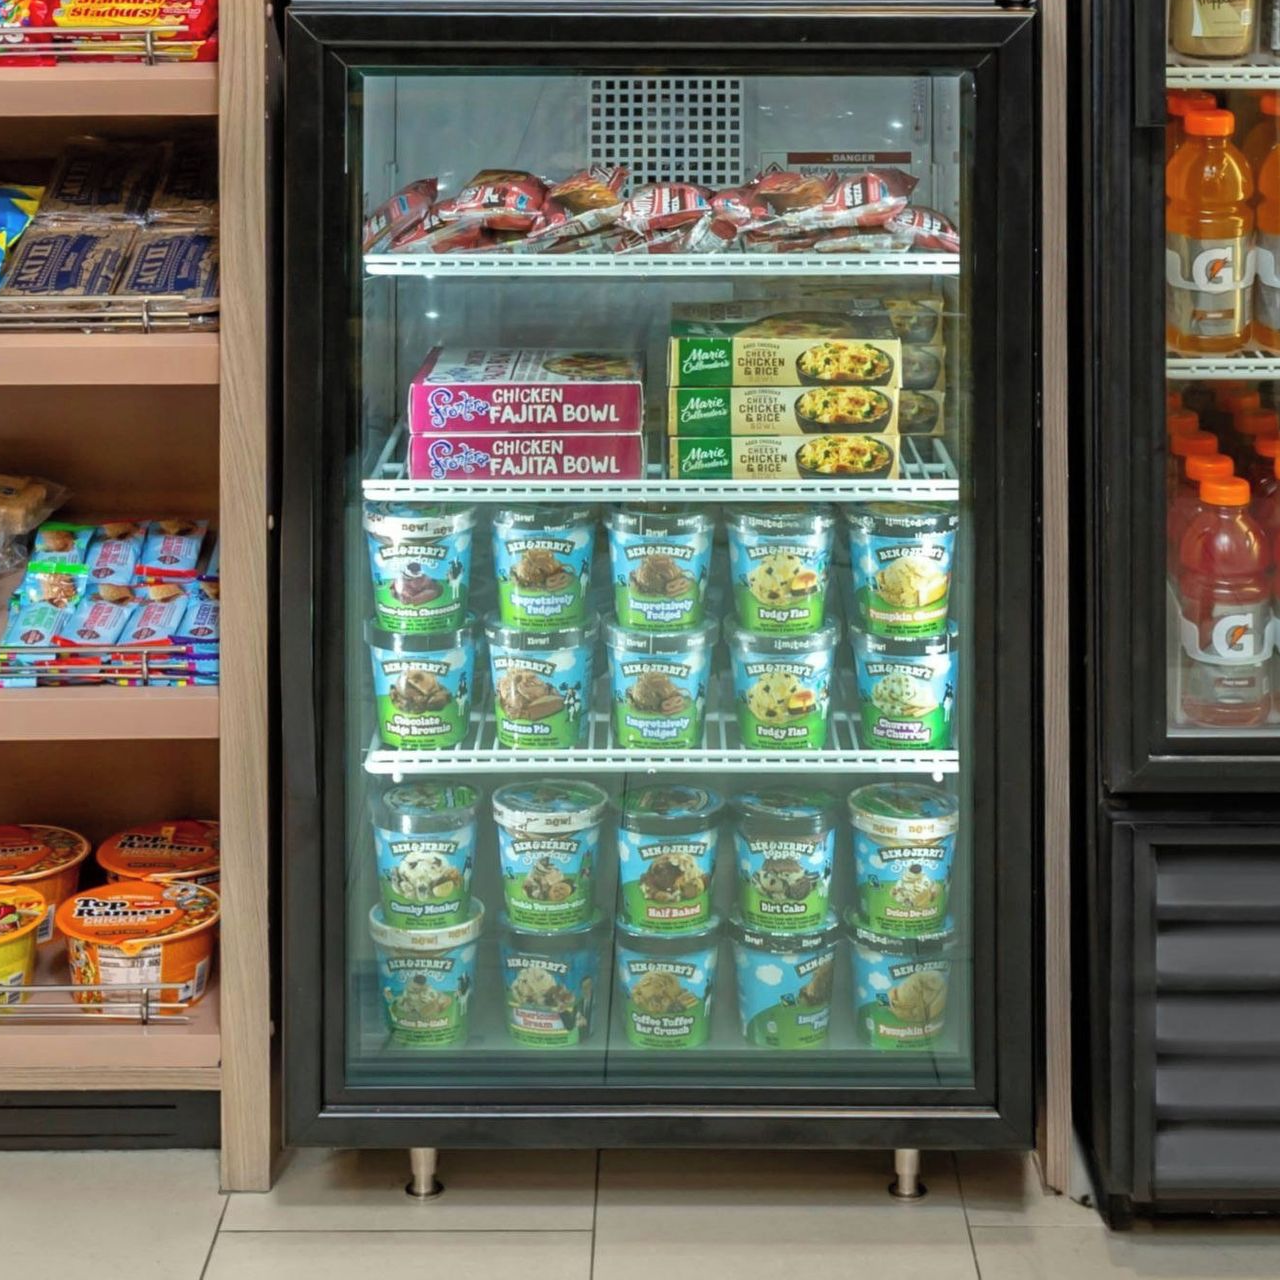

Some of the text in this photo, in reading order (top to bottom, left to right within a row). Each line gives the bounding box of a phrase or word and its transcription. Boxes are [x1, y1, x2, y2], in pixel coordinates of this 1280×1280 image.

[832, 154, 876, 162] DANGER
[1191, 247, 1234, 290] G
[683, 348, 727, 363] Marie
[738, 358, 785, 366] CHICKEN
[744, 367, 779, 376] & RICE
[492, 388, 563, 403] CHICKEN
[682, 397, 725, 413] Marie
[739, 404, 786, 413] CHICKEN
[490, 404, 620, 424] FAJITA BOWL
[745, 413, 780, 422] & RICE
[492, 440, 563, 455] CHICKEN
[683, 447, 726, 462] Marie
[740, 454, 787, 463] CHICKEN
[490, 456, 620, 476] FAJITA BOWL
[535, 540, 572, 552] JERRY'S
[627, 547, 646, 558] BEN
[655, 547, 692, 558] JERRY'S
[1212, 614, 1254, 657] G
[418, 842, 456, 853] JERRY'S
[75, 897, 129, 909] Top
[73, 908, 176, 917] Ramen
